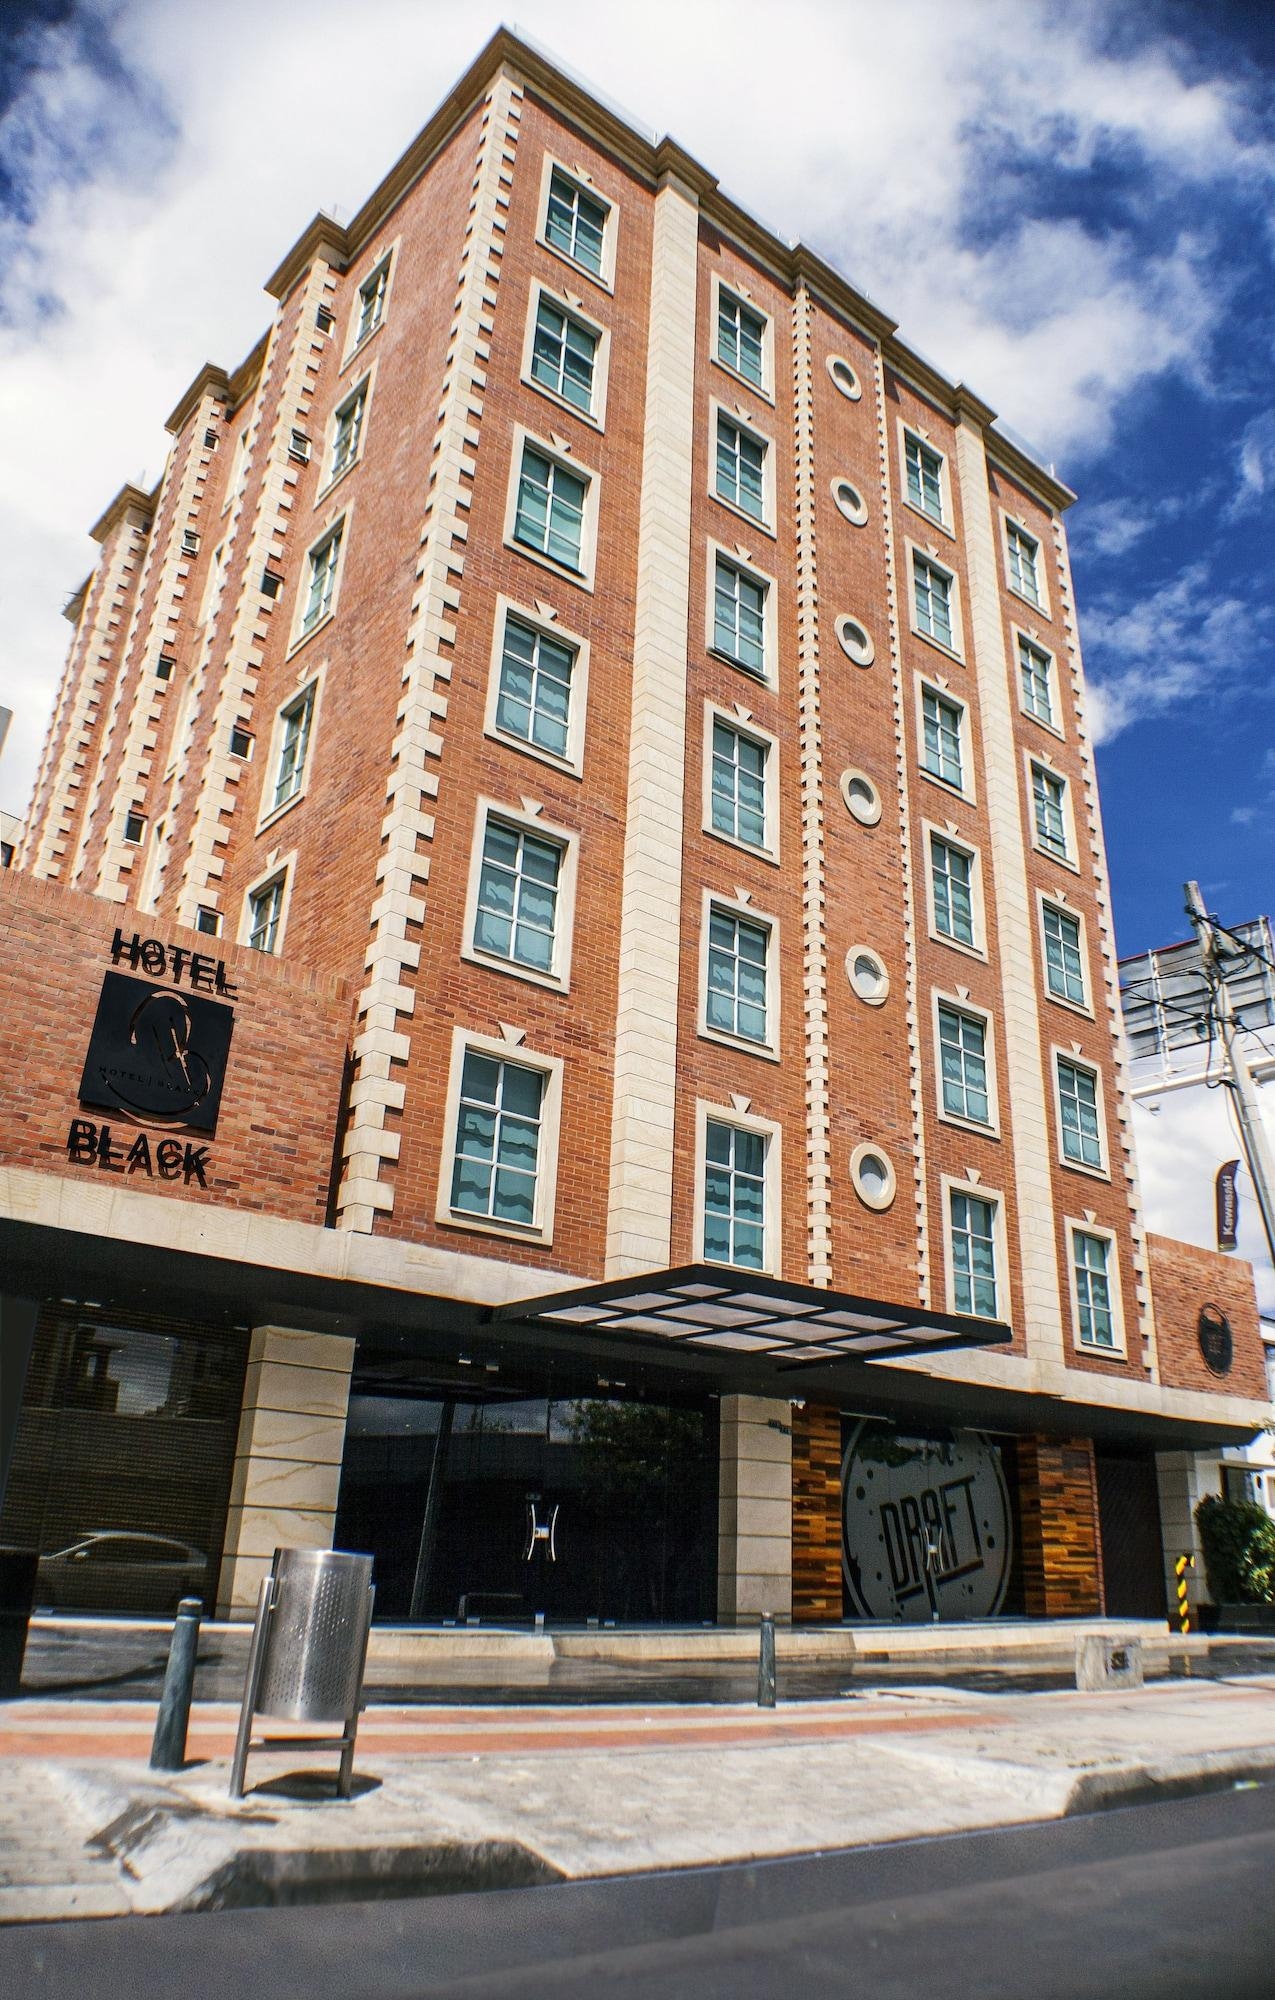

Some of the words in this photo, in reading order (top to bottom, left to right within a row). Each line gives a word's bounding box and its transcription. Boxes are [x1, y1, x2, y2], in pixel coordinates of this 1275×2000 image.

[110, 927, 239, 995] HOTEL
[66, 1119, 210, 1181] BLACK
[1222, 1174, 1234, 1236] Kawasaki
[879, 1475, 983, 1592] DRAFT
